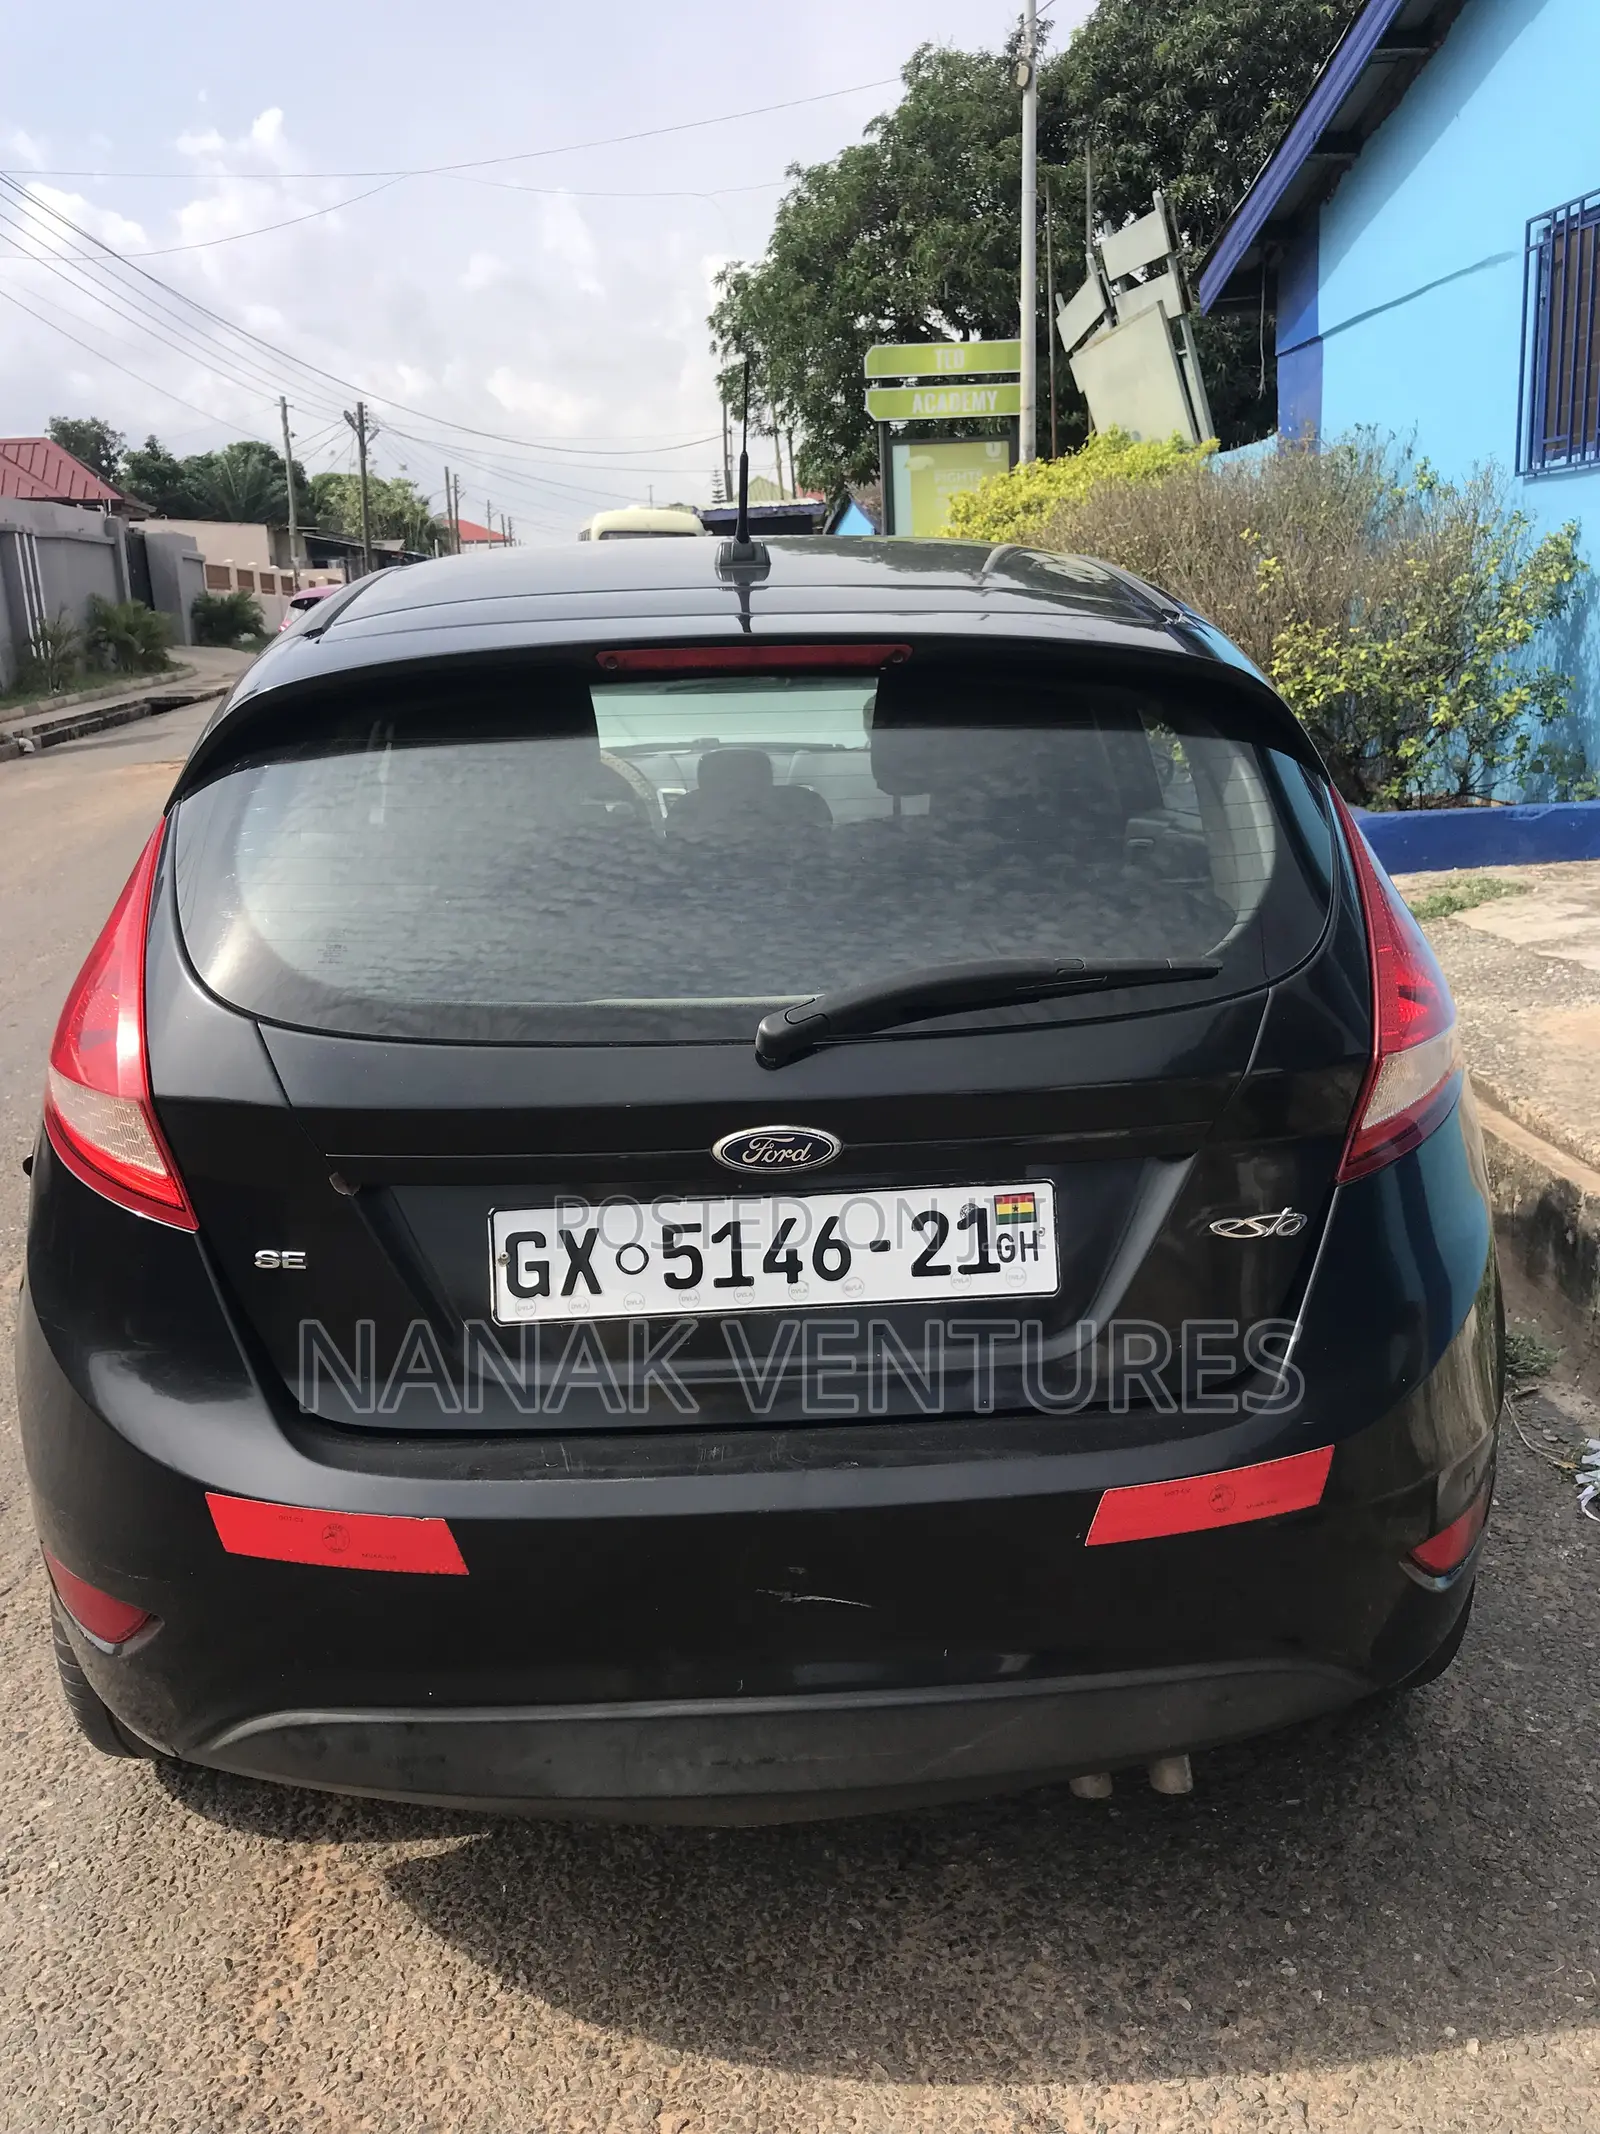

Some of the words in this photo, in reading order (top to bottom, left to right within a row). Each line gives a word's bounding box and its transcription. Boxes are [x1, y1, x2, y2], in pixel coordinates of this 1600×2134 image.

[912, 390, 998, 414] ACADEMY
[742, 1136, 813, 1164] Ford
[254, 1249, 307, 1270] SE
[505, 1228, 603, 1299] GX
[996, 1230, 1040, 1263] GH
